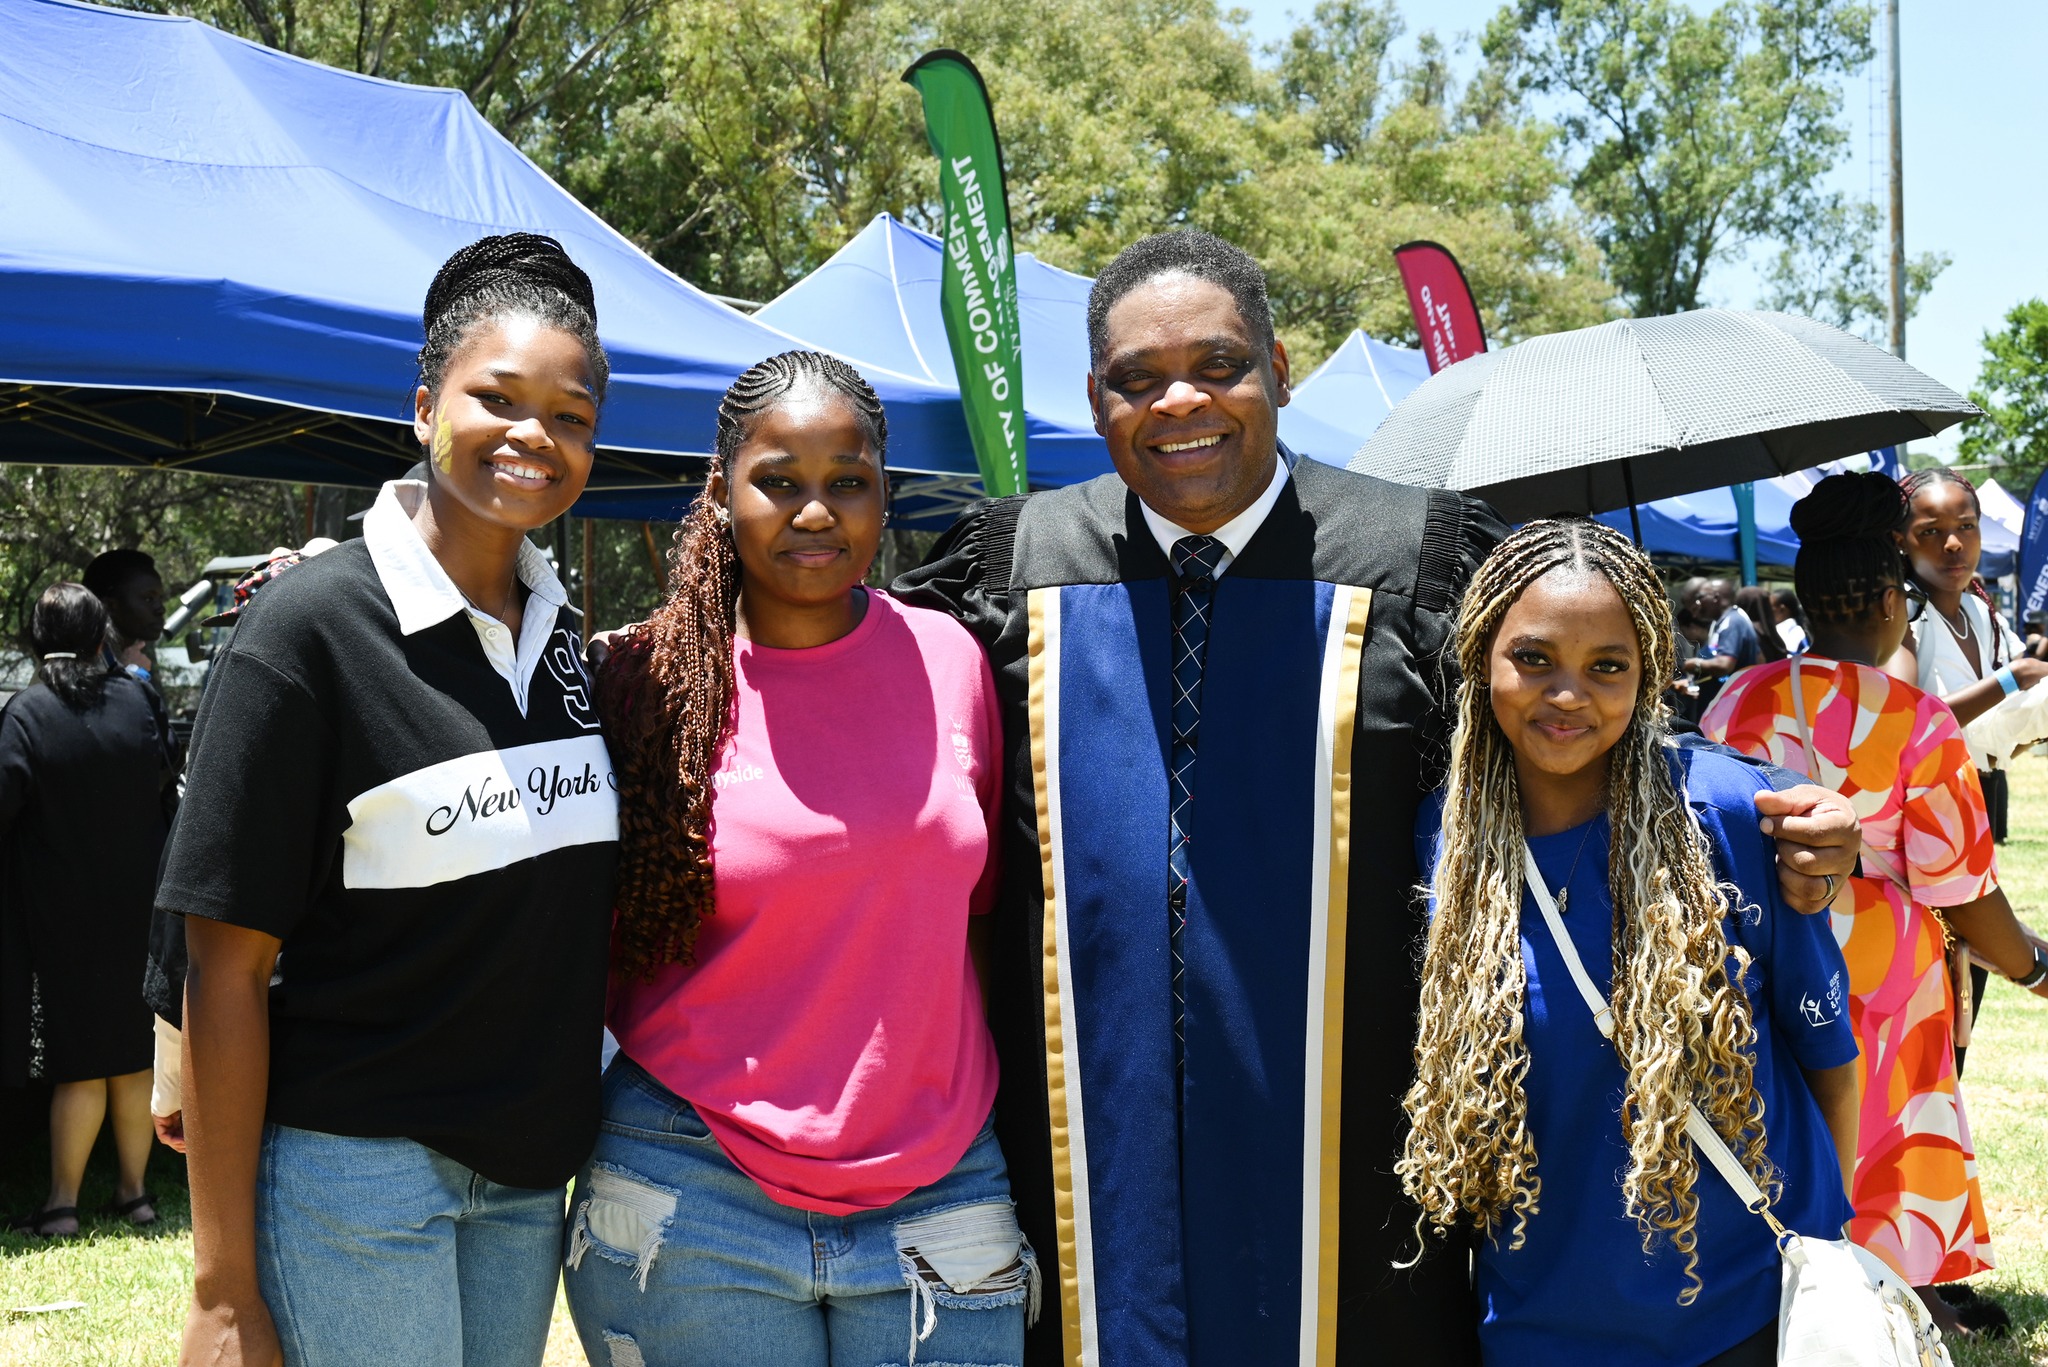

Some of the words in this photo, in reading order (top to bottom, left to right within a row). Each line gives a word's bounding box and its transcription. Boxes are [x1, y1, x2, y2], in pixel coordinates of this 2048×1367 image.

[1433, 330, 1450, 369] ING
[983, 360, 1009, 401] OF
[544, 628, 601, 729] 9
[711, 764, 764, 790] nyside
[426, 776, 520, 836] New
[527, 763, 601, 816] York
